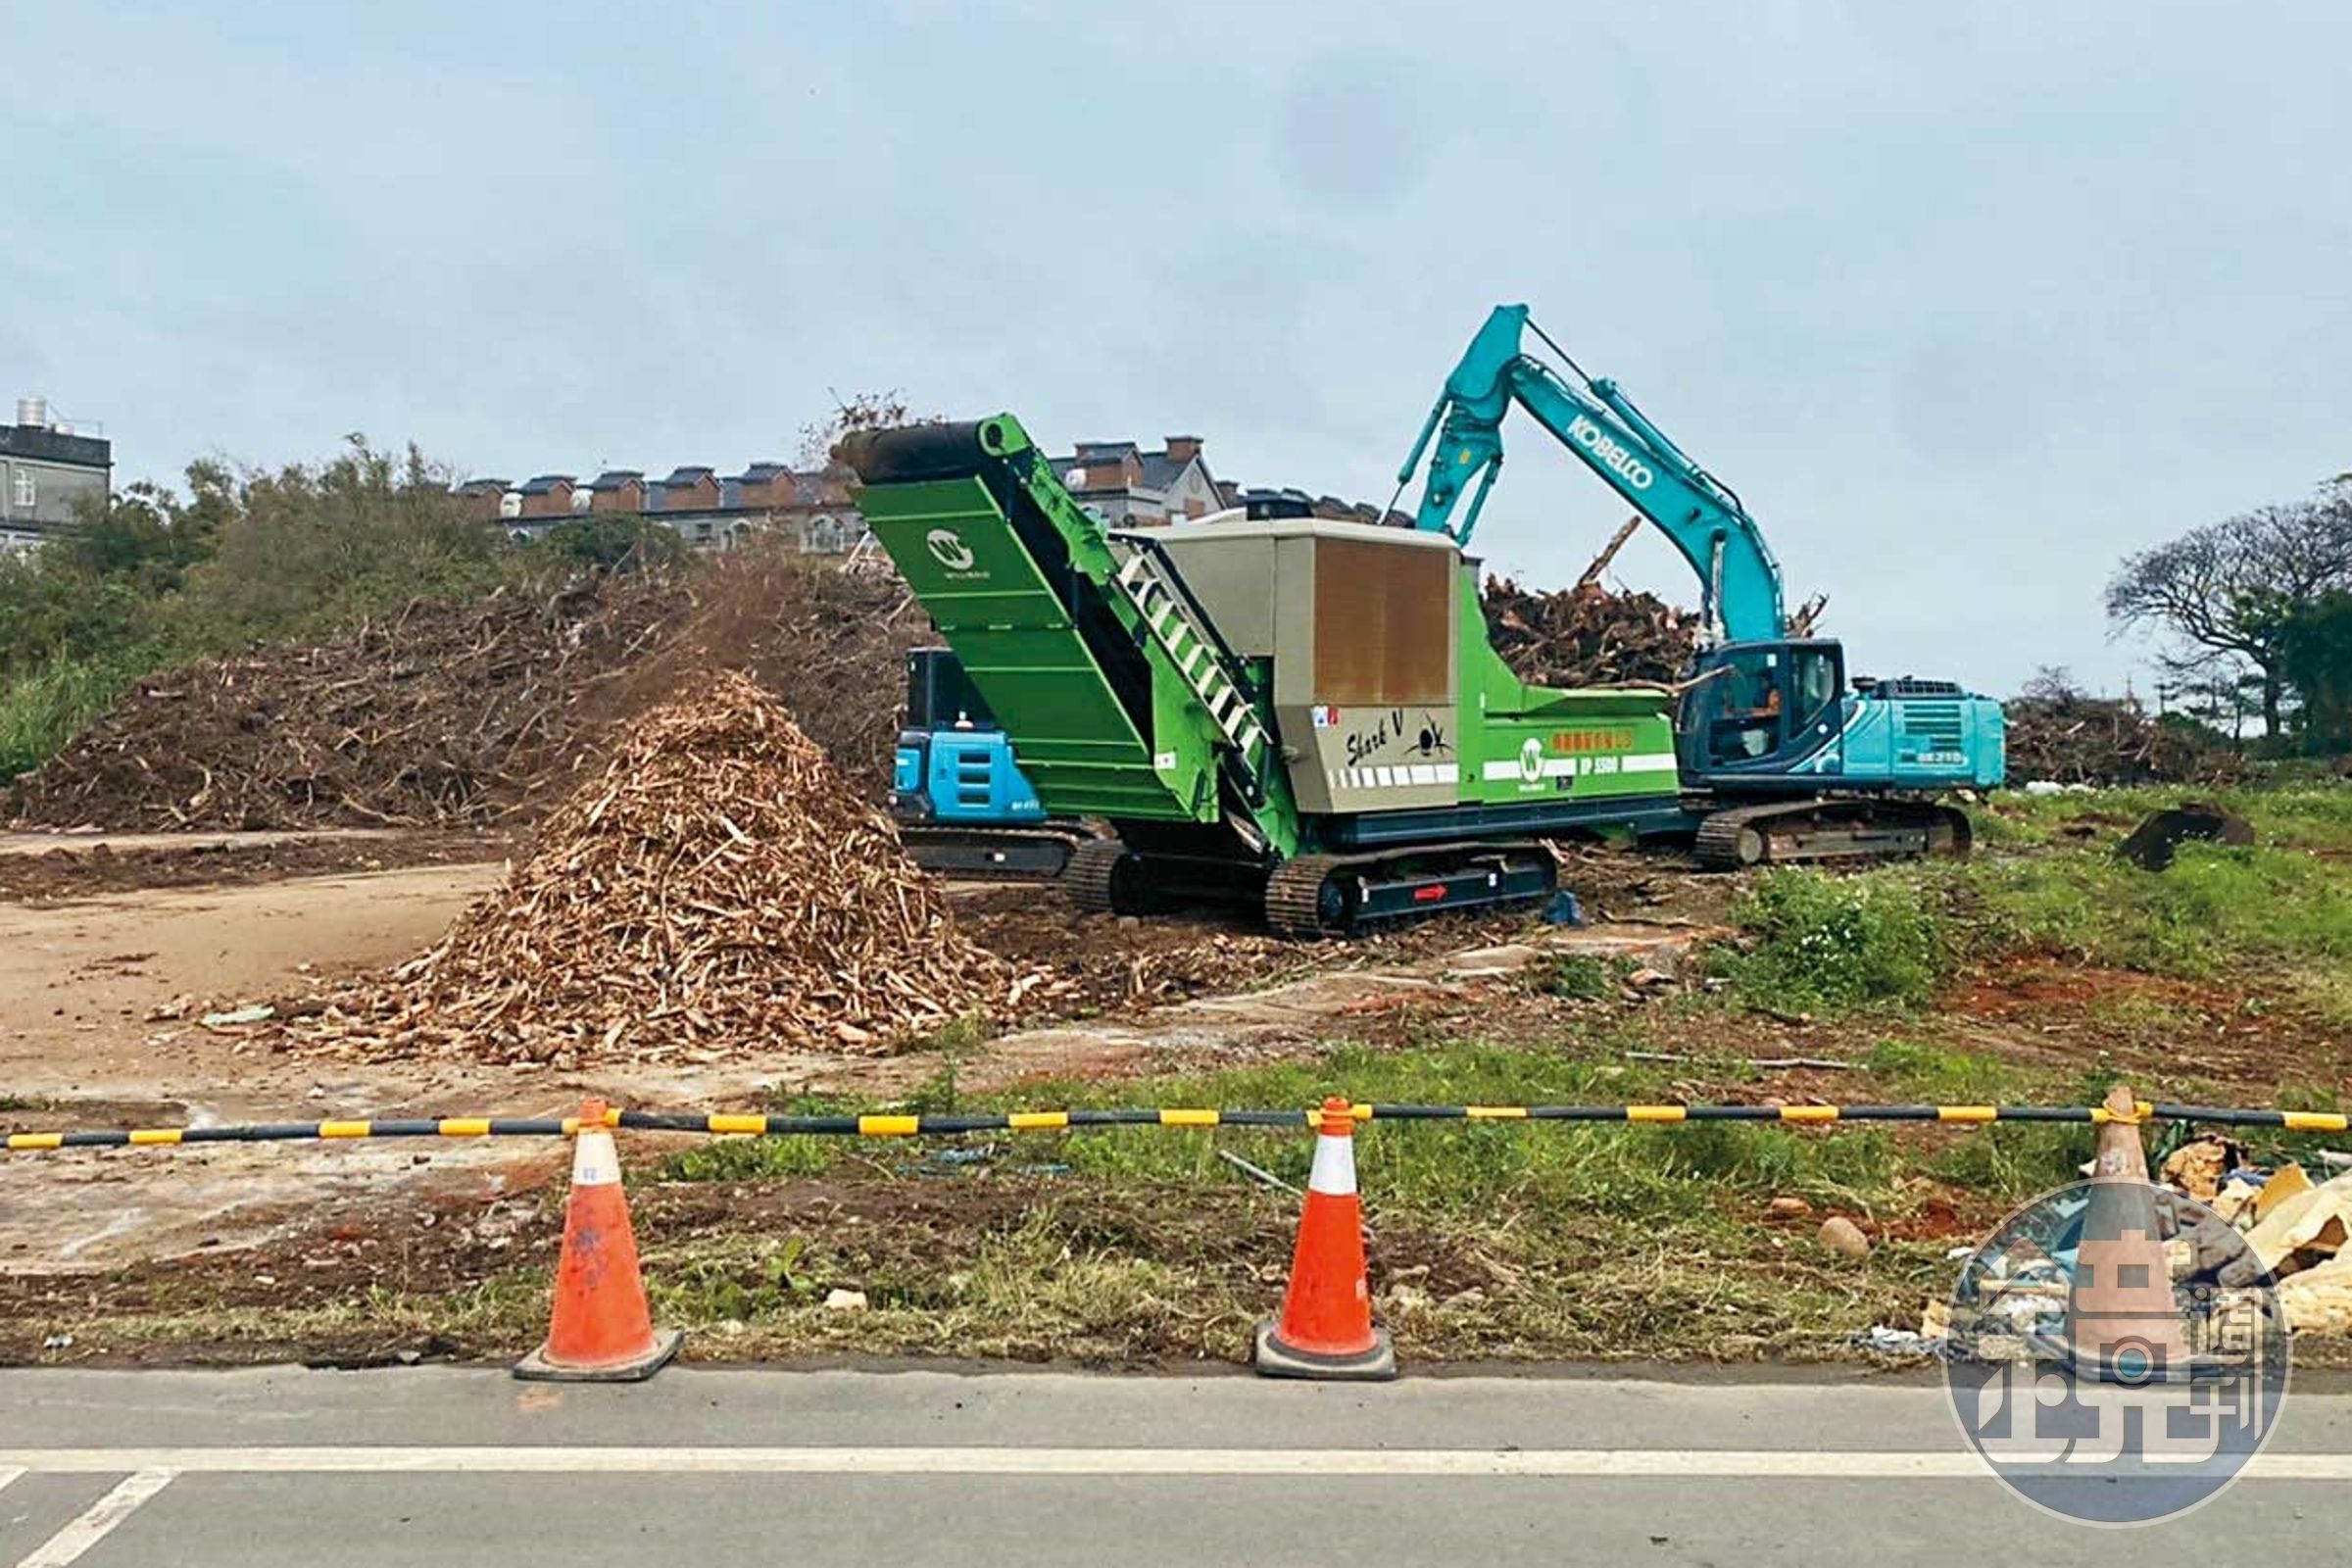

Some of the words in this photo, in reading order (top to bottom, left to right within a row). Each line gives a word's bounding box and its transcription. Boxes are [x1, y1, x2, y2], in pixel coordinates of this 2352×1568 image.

[1567, 414, 1654, 489] KOBELCO
[1346, 717, 1387, 766] Shark
[1392, 708, 1403, 736] V
